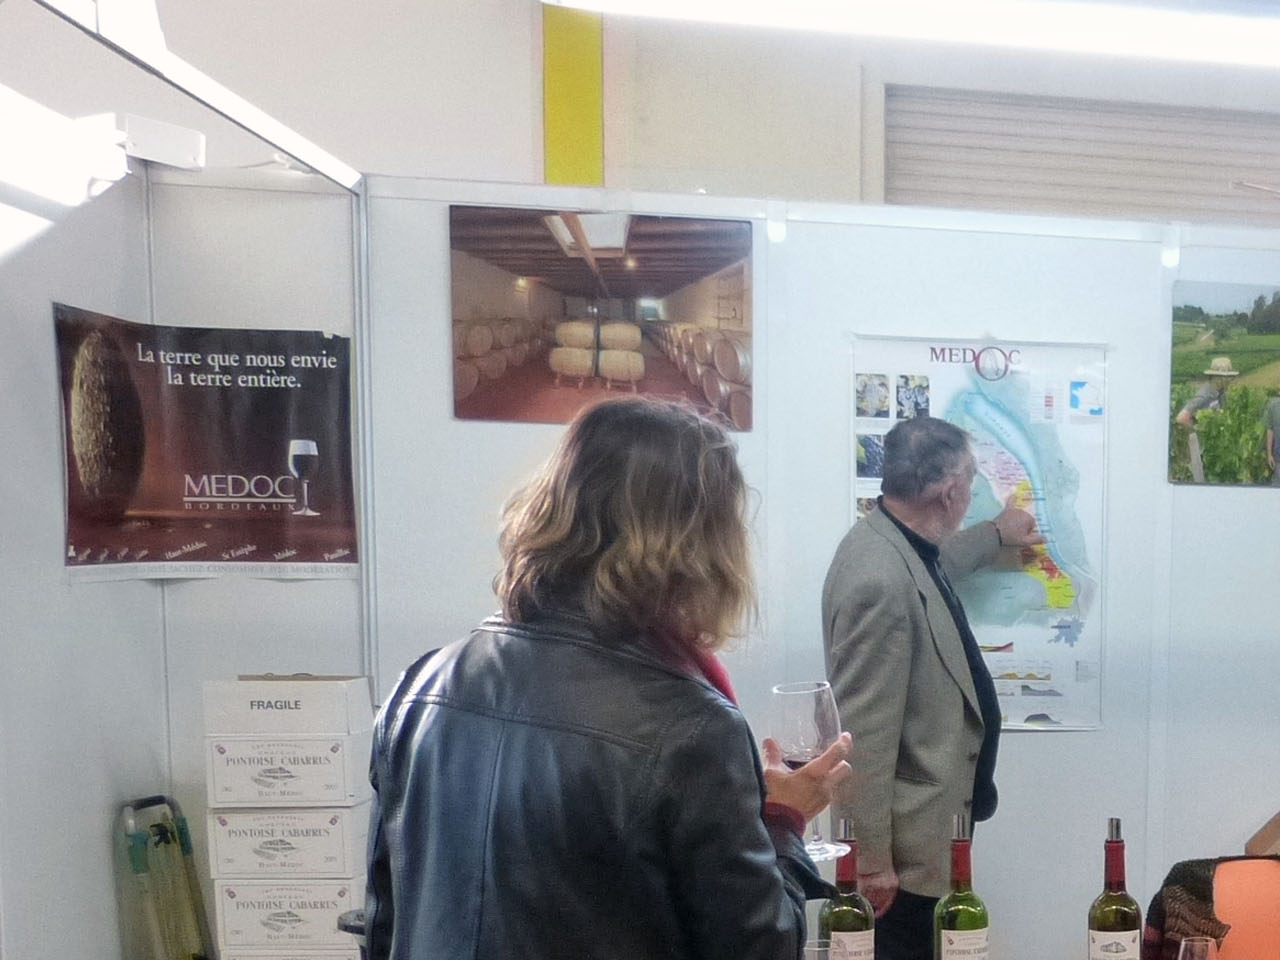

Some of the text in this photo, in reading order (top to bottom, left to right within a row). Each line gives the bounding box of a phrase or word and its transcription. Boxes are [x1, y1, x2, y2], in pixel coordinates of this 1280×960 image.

[137, 343, 337, 371] La terre que nous envie
[928, 346, 1021, 382] MEDOC
[167, 366, 301, 388] la terre entière.
[184, 474, 295, 498] MEDOC
[185, 503, 295, 511] BORDEAUX
[250, 700, 302, 711] FRAGILE
[226, 755, 331, 767] PONTOISE CABARRUS
[281, 828, 330, 838] CABARRUS
[236, 900, 338, 911] PONTOISE CABARRUS
